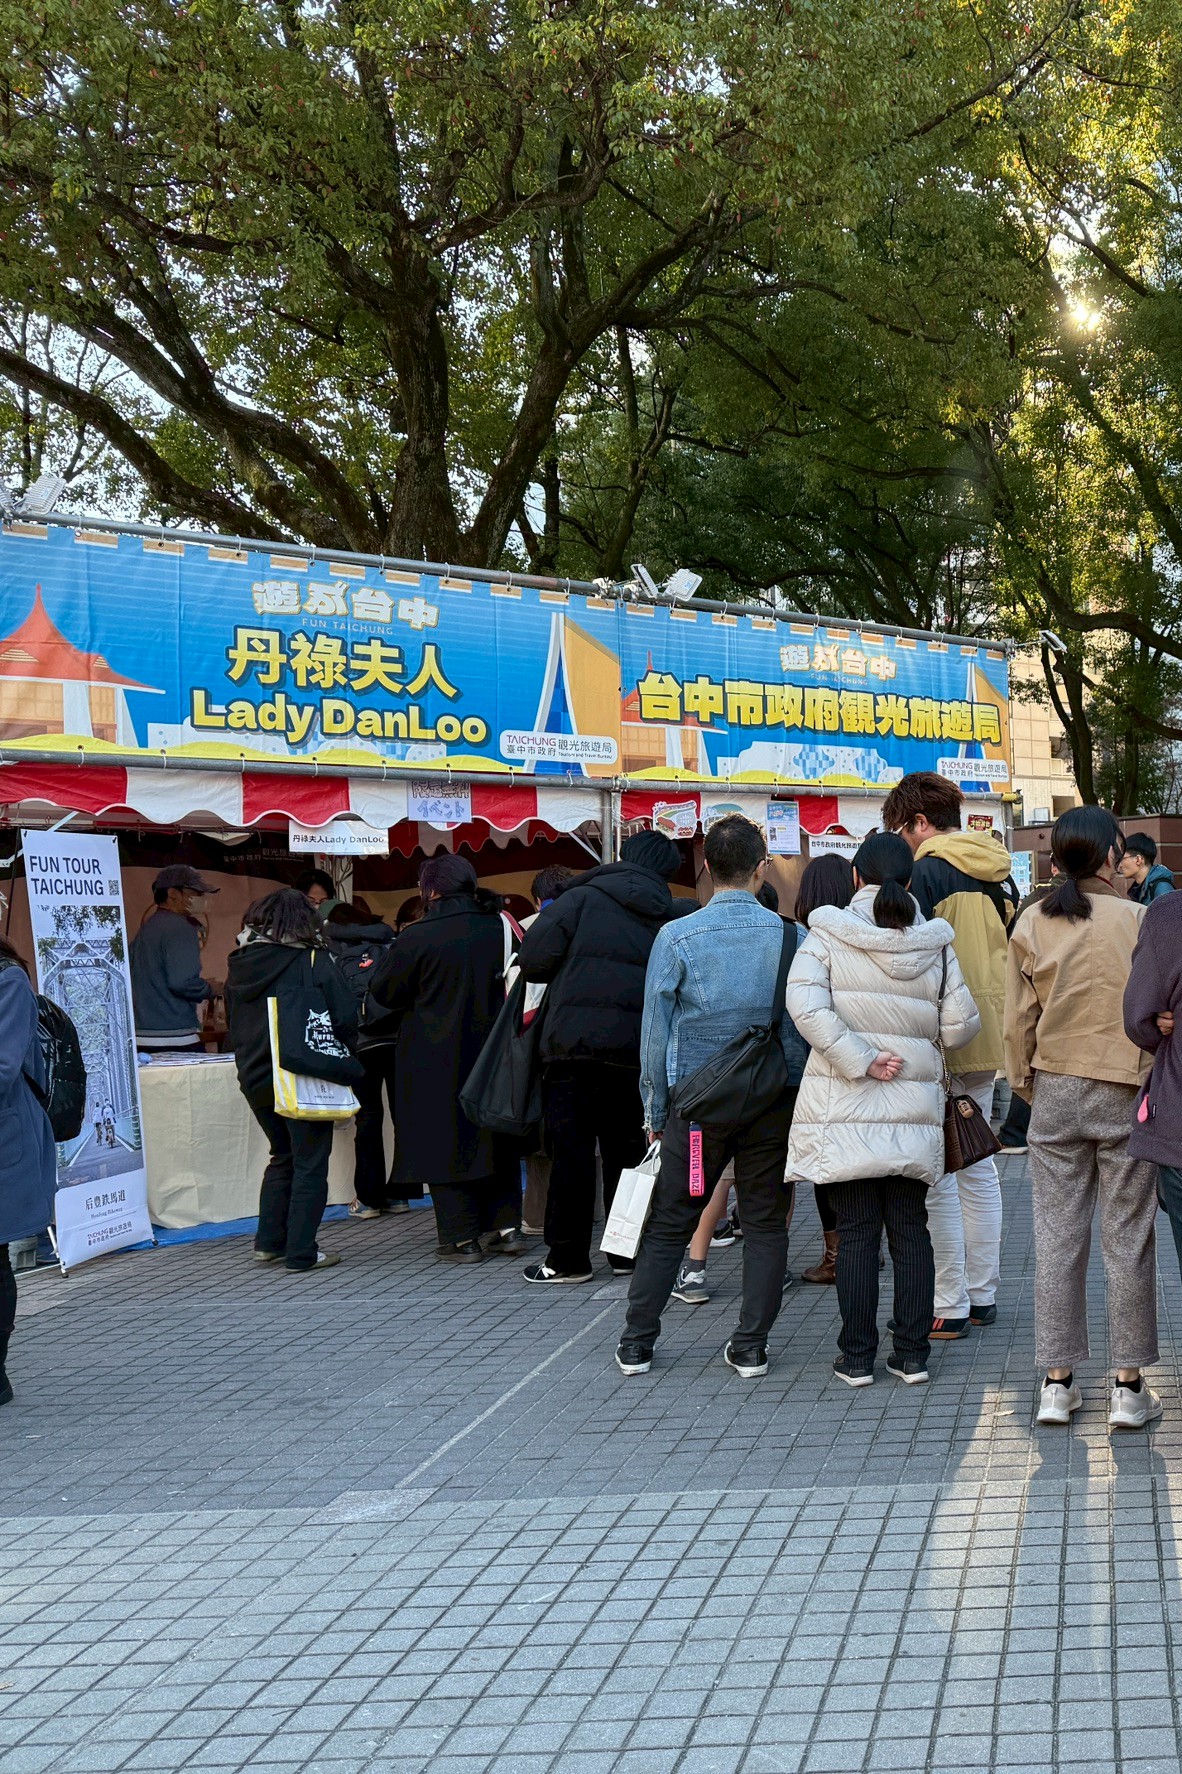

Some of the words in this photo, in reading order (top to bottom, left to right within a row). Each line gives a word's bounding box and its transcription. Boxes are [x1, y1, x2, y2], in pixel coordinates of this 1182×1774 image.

[302, 618, 327, 628] FUN
[333, 621, 393, 635] TAICHUNG
[193, 690, 313, 743] Lady
[323, 699, 487, 743] DanLoo
[506, 735, 556, 746] TAICHUNG
[29, 855, 60, 873] FUN
[62, 857, 102, 875] TOUR
[31, 878, 104, 895] TAICHUNG
